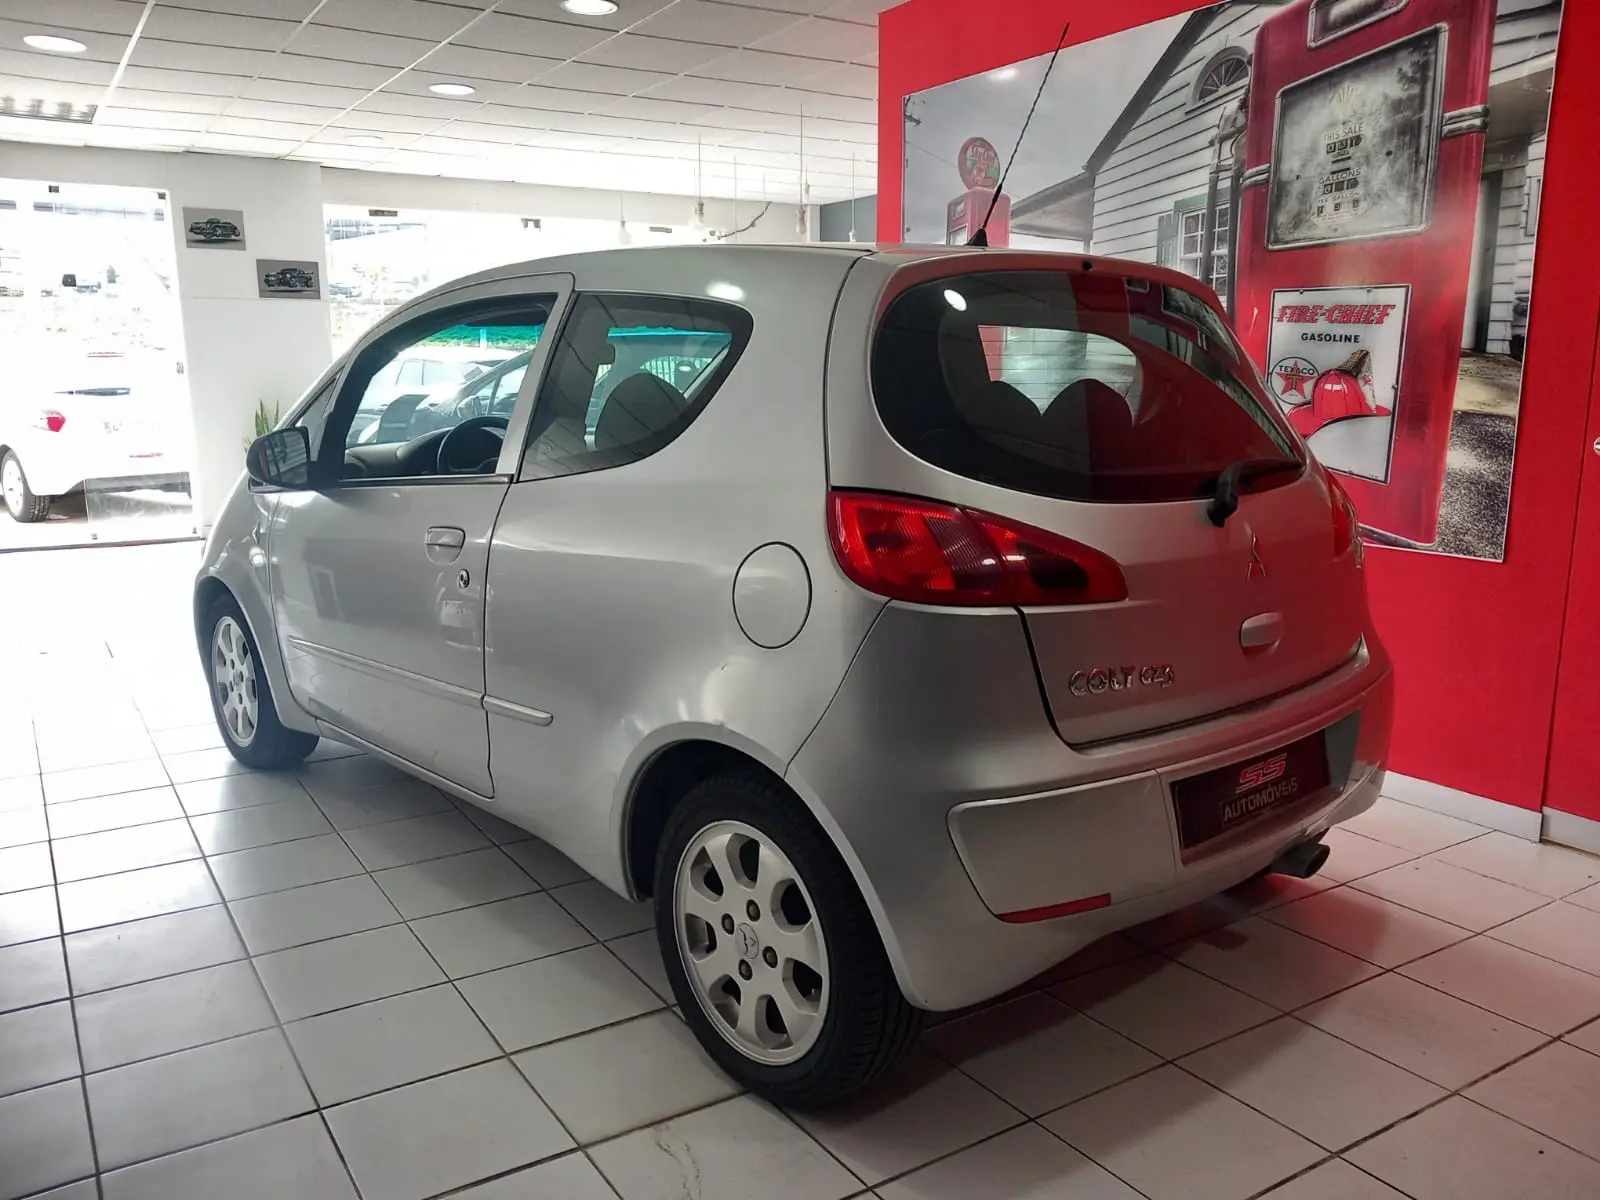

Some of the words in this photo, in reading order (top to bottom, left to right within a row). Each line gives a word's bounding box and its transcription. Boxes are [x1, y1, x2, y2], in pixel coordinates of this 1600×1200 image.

[1323, 130, 1341, 142] THIS
[1342, 124, 1363, 136] SALE
[1319, 168, 1361, 184] GALLONS
[1274, 304, 1396, 325] FIRE-CHIEF
[1301, 333, 1361, 344] GASOLINE
[1279, 364, 1315, 375] TEXACO
[1069, 666, 1136, 696] COLT
[1223, 776, 1298, 822] AUTOMÓVEIS
